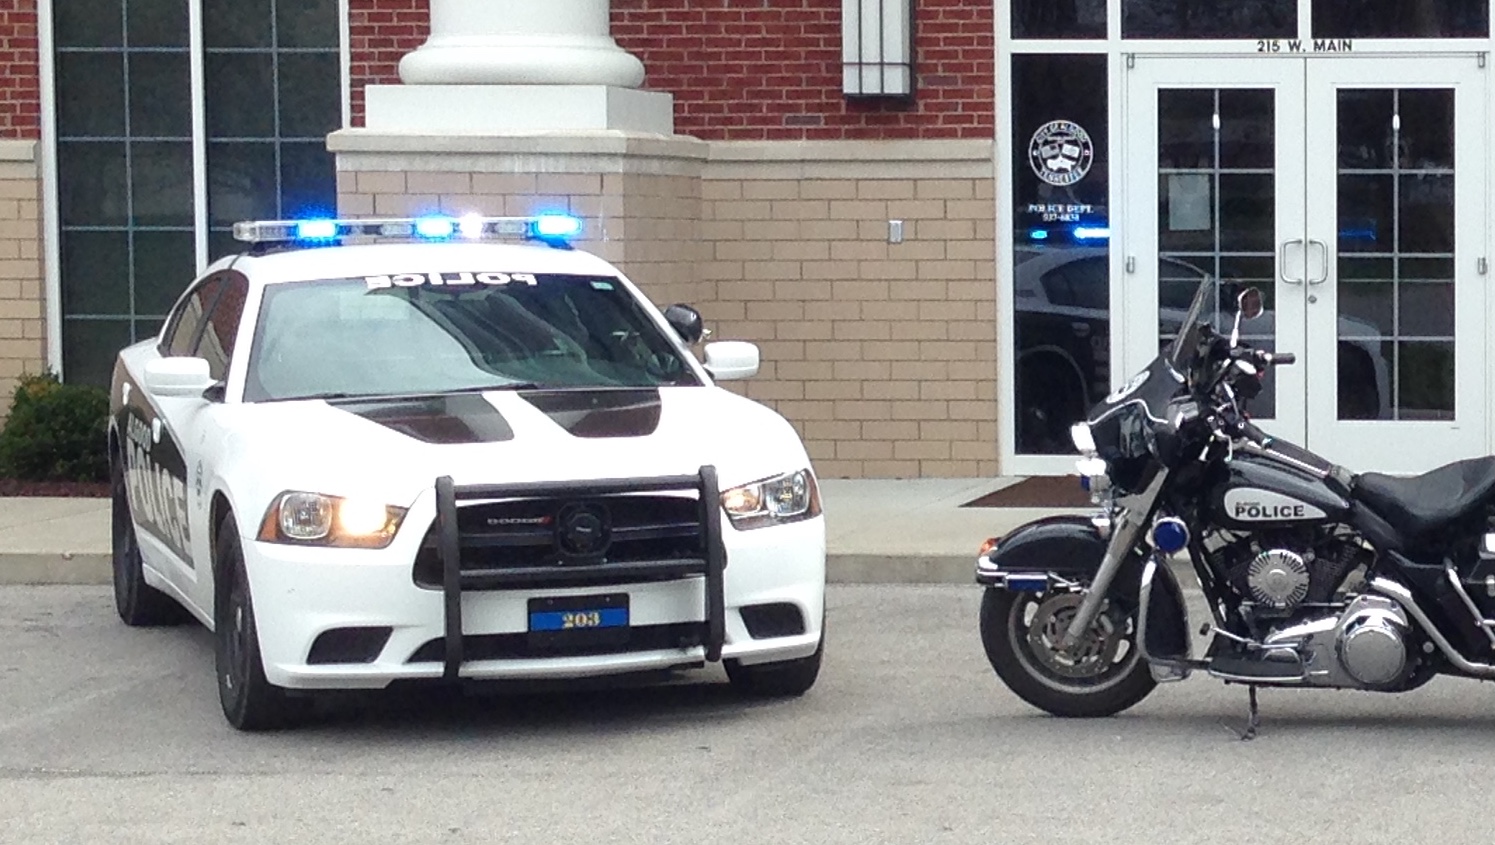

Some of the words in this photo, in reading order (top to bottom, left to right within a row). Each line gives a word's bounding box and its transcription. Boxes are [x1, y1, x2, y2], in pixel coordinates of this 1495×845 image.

[1257, 40, 1280, 52] 215
[1288, 40, 1306, 52] W.
[1313, 40, 1353, 52] MAIN
[127, 436, 192, 560] POLICE
[1235, 505, 1305, 518] POLICE
[562, 612, 600, 628] 203
